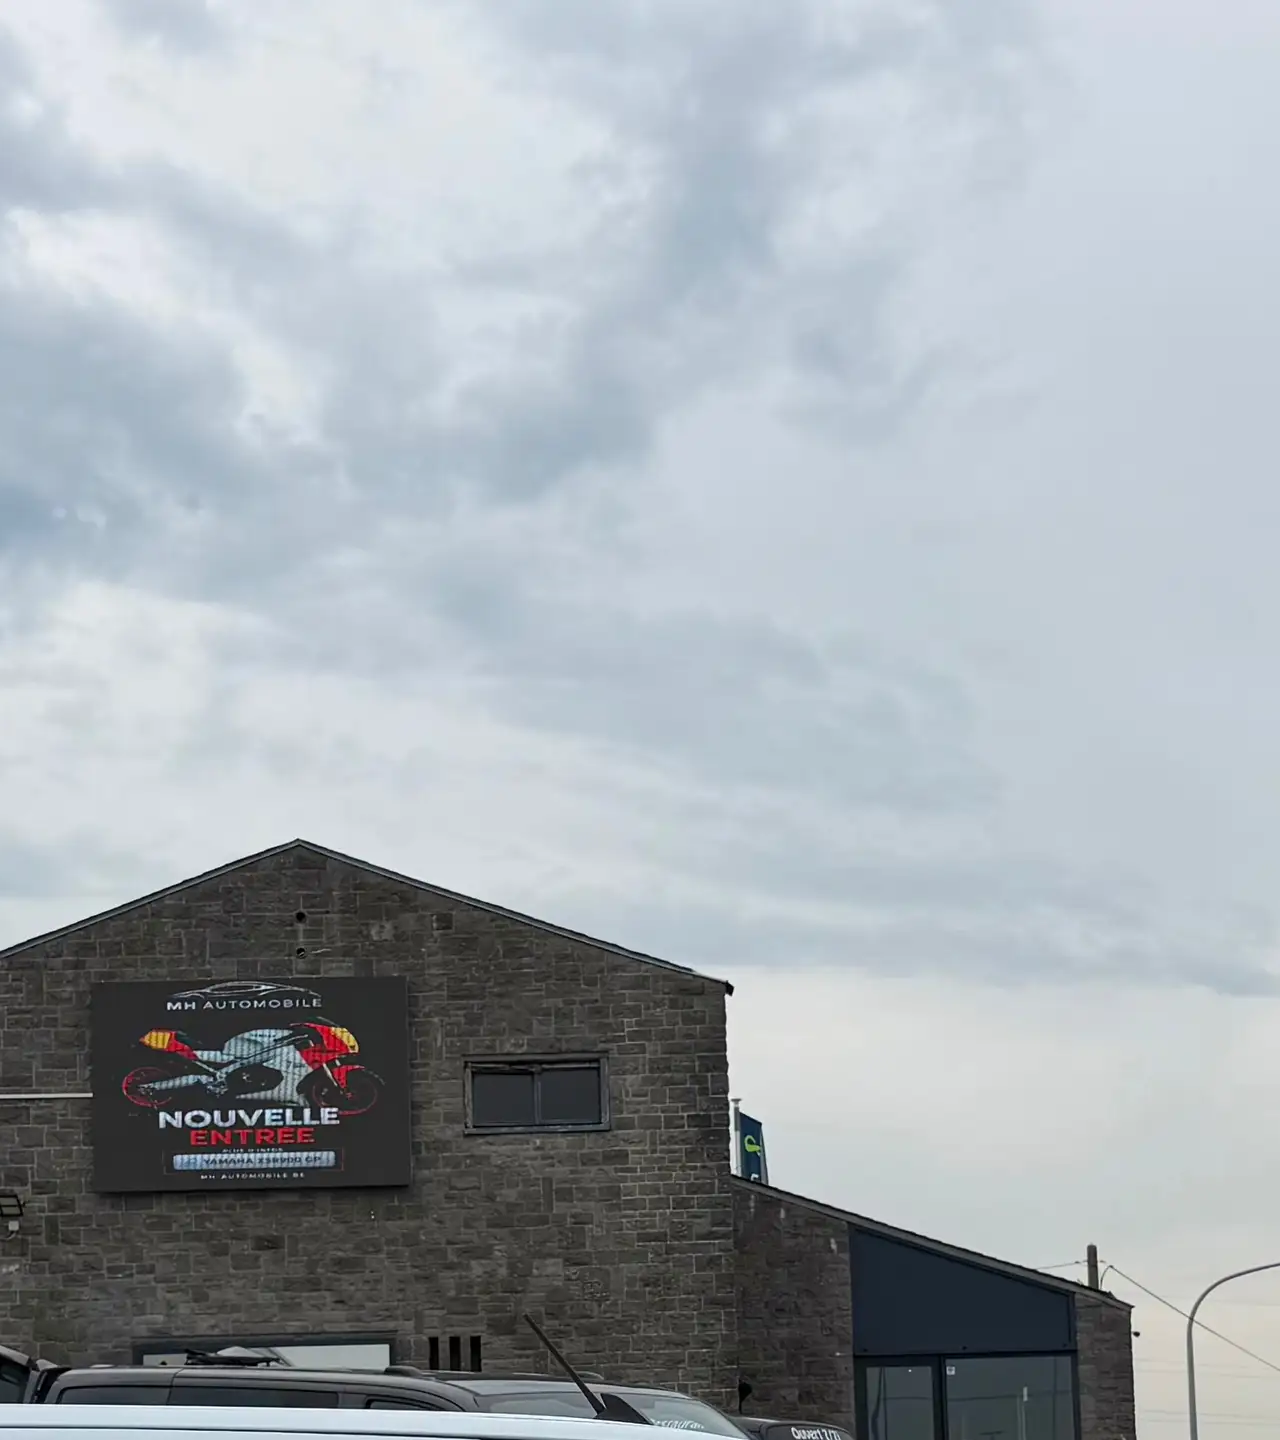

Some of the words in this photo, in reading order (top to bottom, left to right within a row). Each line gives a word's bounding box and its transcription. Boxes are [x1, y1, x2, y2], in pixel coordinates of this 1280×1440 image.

[166, 1001, 197, 1011] MH
[202, 998, 322, 1010] AUTOMOBILE
[158, 1107, 340, 1129] NOUVELLE
[203, 1157, 253, 1166] YAMAHA
[791, 1427, 823, 1440] Ouvert
